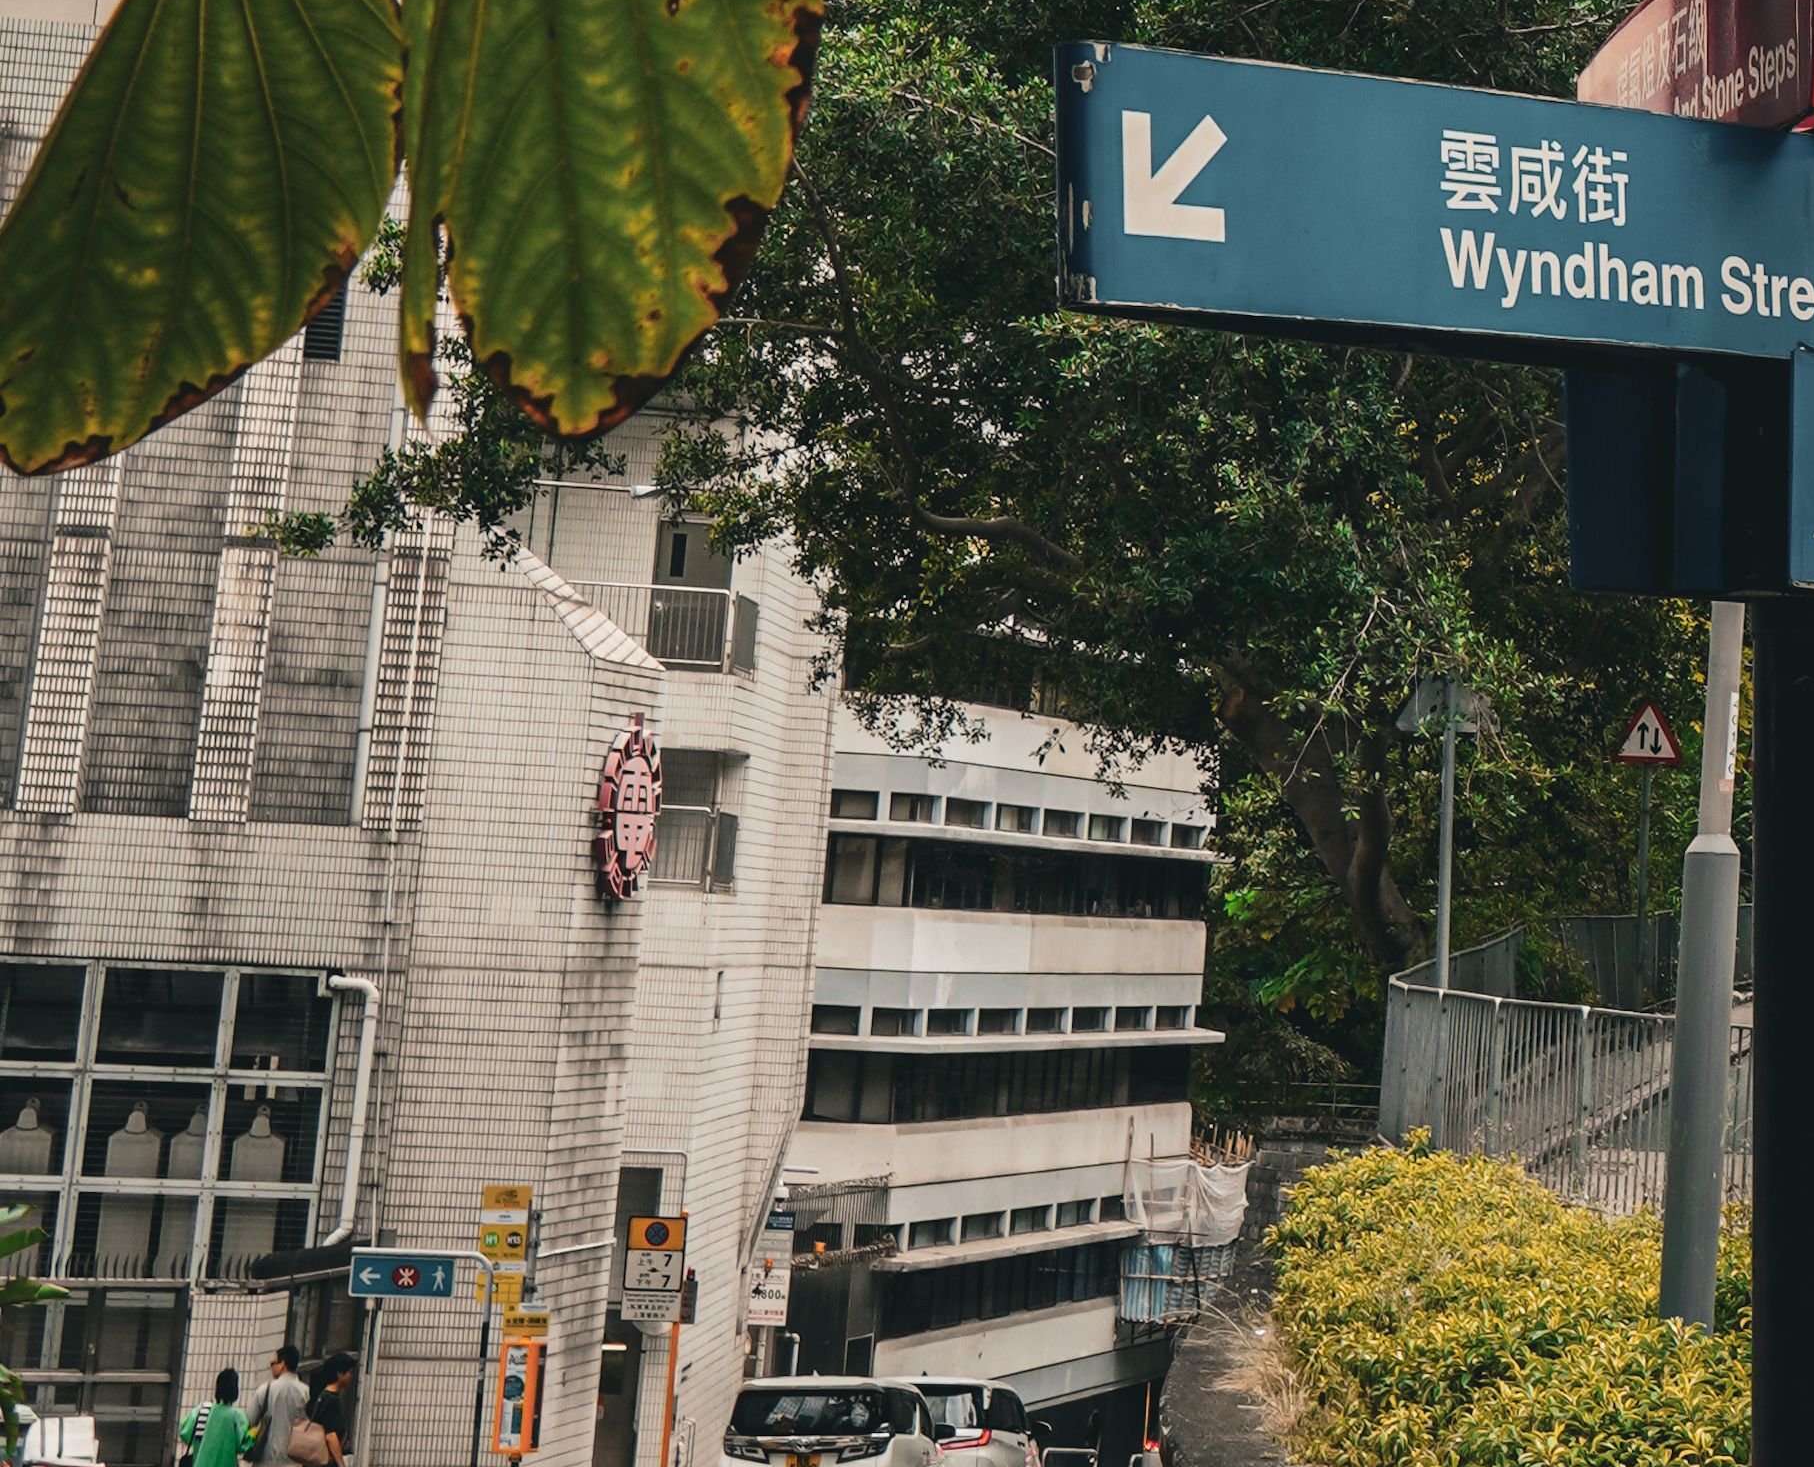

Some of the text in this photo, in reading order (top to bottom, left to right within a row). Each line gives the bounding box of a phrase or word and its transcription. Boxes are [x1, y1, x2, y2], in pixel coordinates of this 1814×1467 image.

[1702, 67, 1744, 119] Stone
[1749, 36, 1796, 99] Steps
[1440, 129, 1629, 227] 雲咸街
[1440, 227, 1705, 310] Wyndham
[662, 1274, 671, 1288] 7
[664, 1254, 673, 1267] 7
